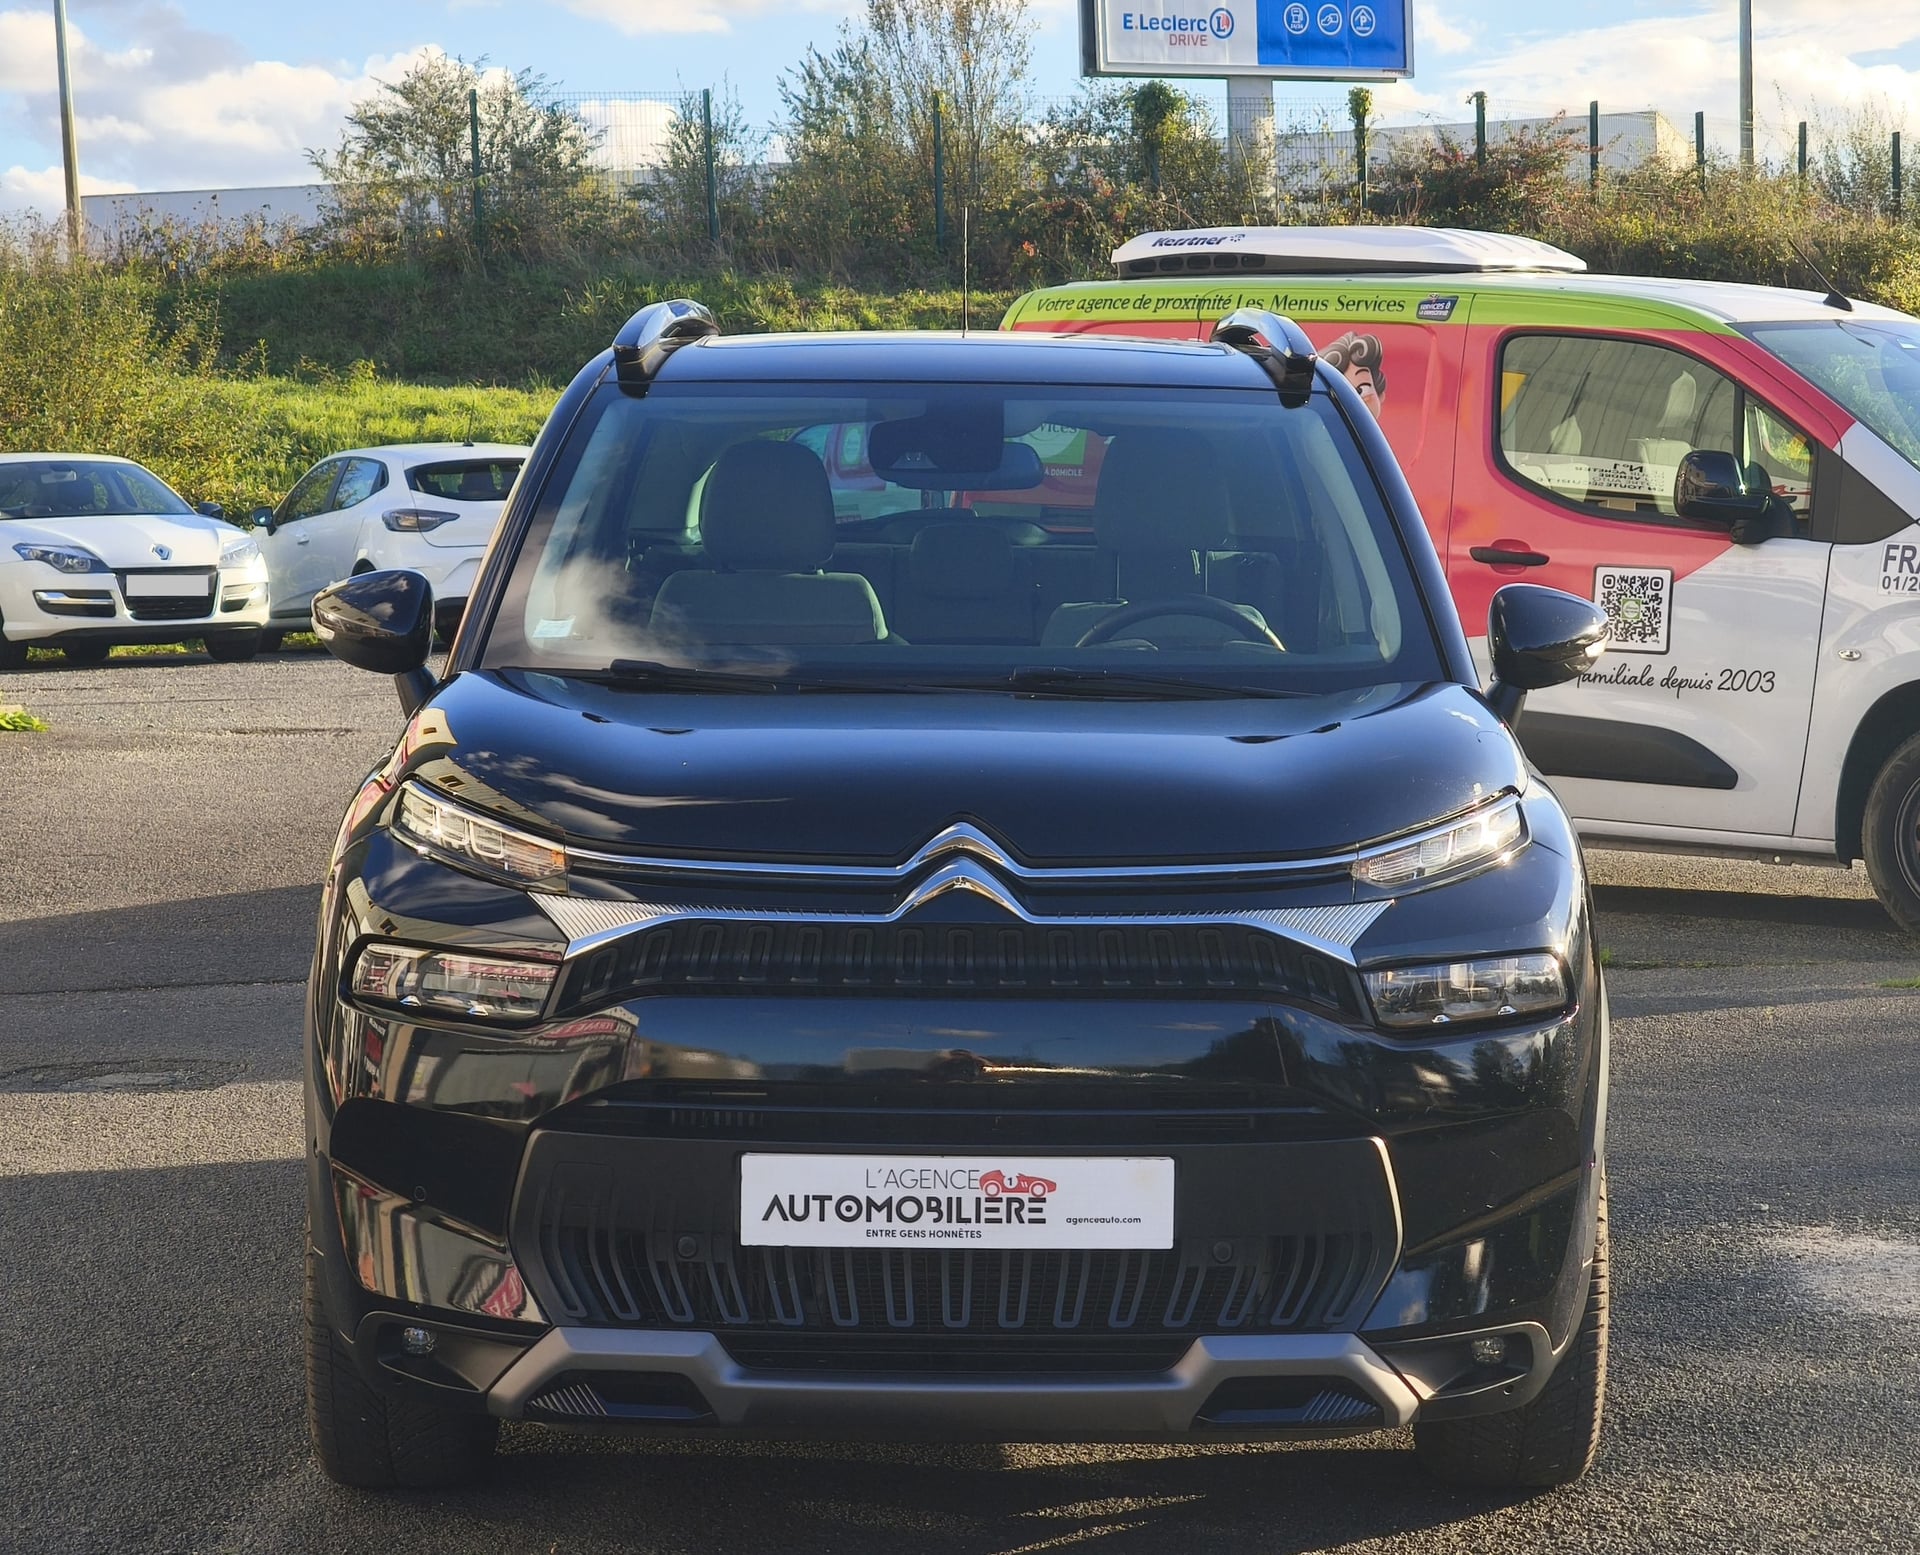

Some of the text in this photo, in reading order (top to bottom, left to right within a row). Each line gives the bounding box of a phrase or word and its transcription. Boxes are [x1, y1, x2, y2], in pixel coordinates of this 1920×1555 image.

[1123, 13, 1207, 32] E.Leclerc
[1169, 33, 1208, 46] DRIVE
[1037, 297, 1073, 312] Votre
[1076, 296, 1131, 314] agence
[1133, 294, 1151, 310] de
[1152, 294, 1231, 313] proximité
[1268, 294, 1329, 312] Menus
[1334, 294, 1406, 312] Services
[1051, 468, 1083, 477] DOMICILE
[1883, 544, 1920, 574] FR
[1882, 576, 1920, 591] 01/2
[1660, 665, 1713, 699] depuis
[1717, 668, 1776, 693] 2003
[866, 1168, 1013, 1190] L'AGENCE 1
[1066, 1216, 1141, 1226] agenceauto.com
[866, 1227, 982, 1239] ENTRE GENS HONNÊTES
